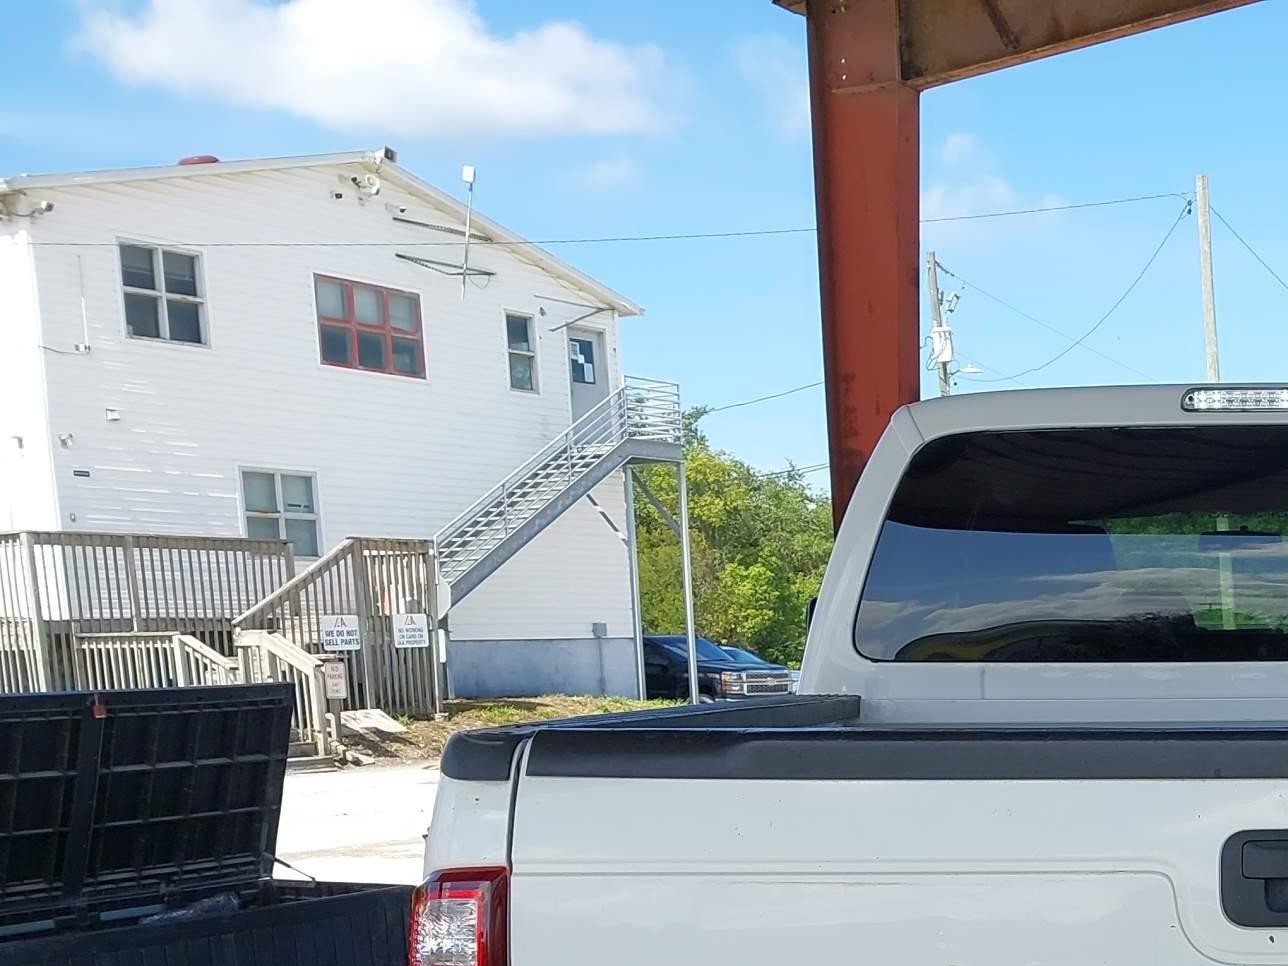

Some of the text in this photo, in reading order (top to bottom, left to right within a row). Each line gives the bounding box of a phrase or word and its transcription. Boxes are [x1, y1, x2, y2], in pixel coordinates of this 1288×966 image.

[325, 629, 357, 638] WE DO NOT
[324, 638, 360, 646] SELL PARTS
